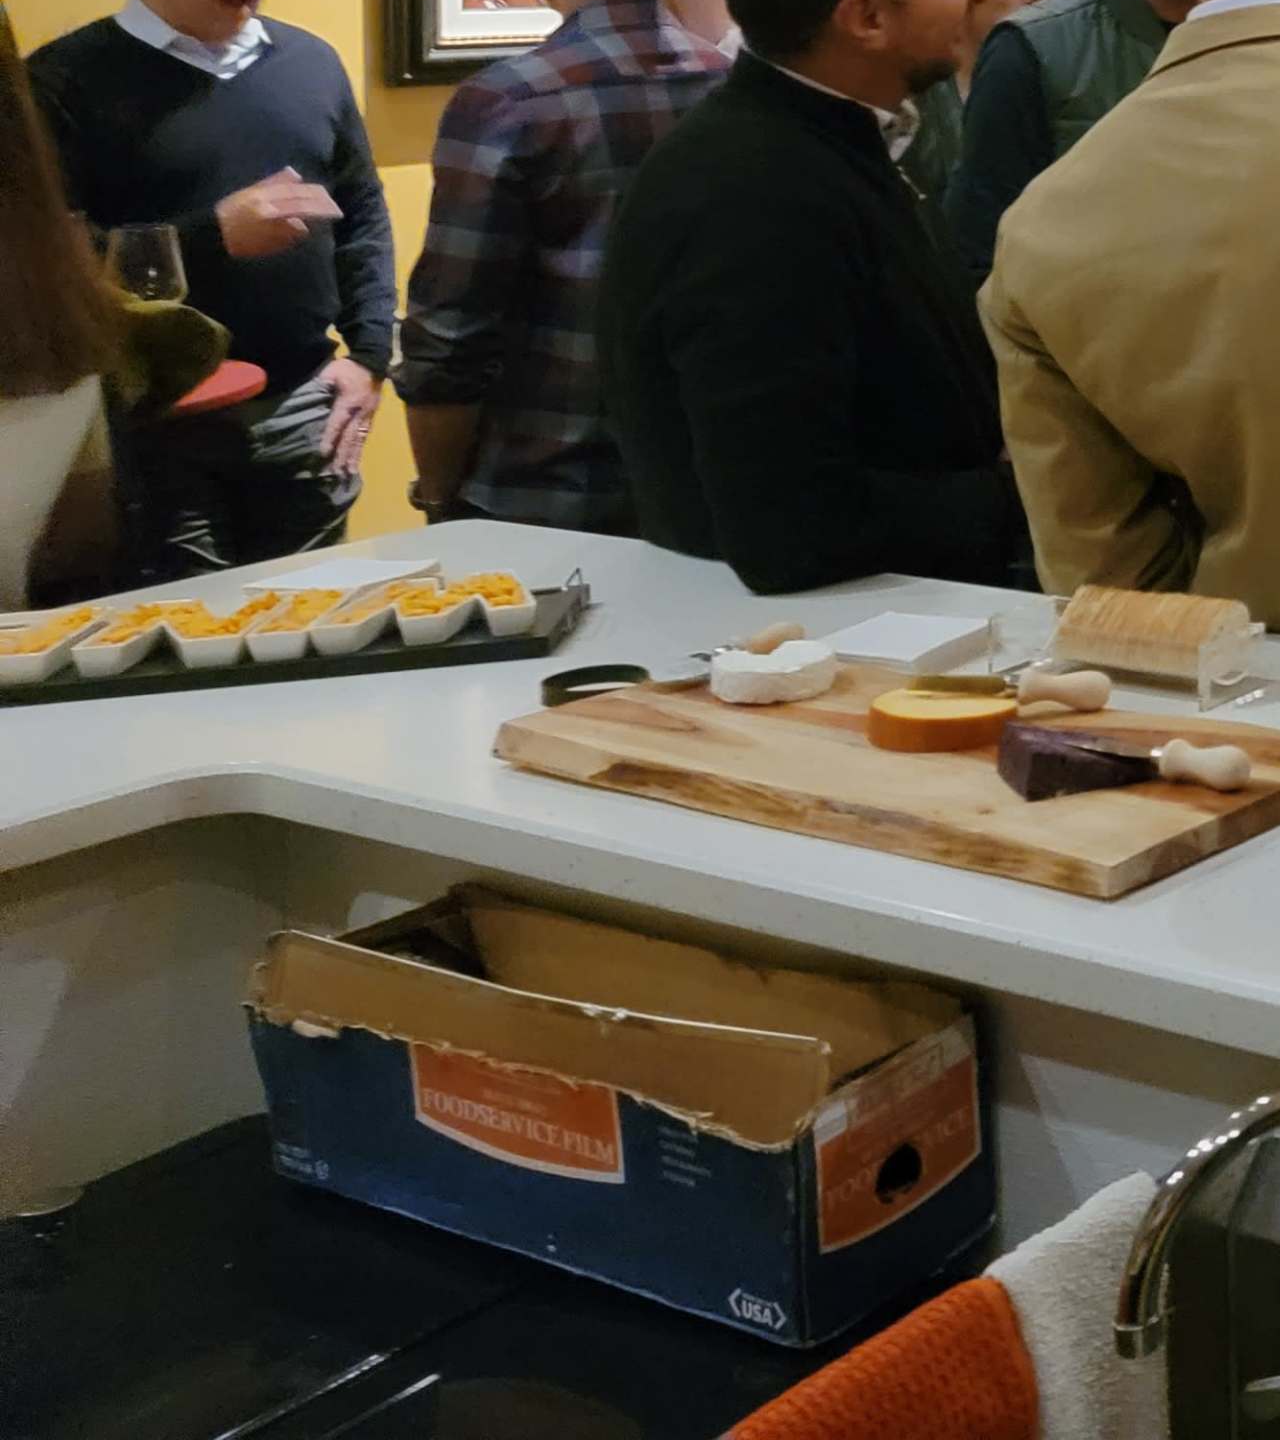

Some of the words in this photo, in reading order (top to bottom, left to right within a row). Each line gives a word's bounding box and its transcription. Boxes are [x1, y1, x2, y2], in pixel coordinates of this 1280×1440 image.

[423, 1087, 560, 1148] FOODSERVICE
[561, 1129, 615, 1166] FILM
[741, 1300, 773, 1327] USA
